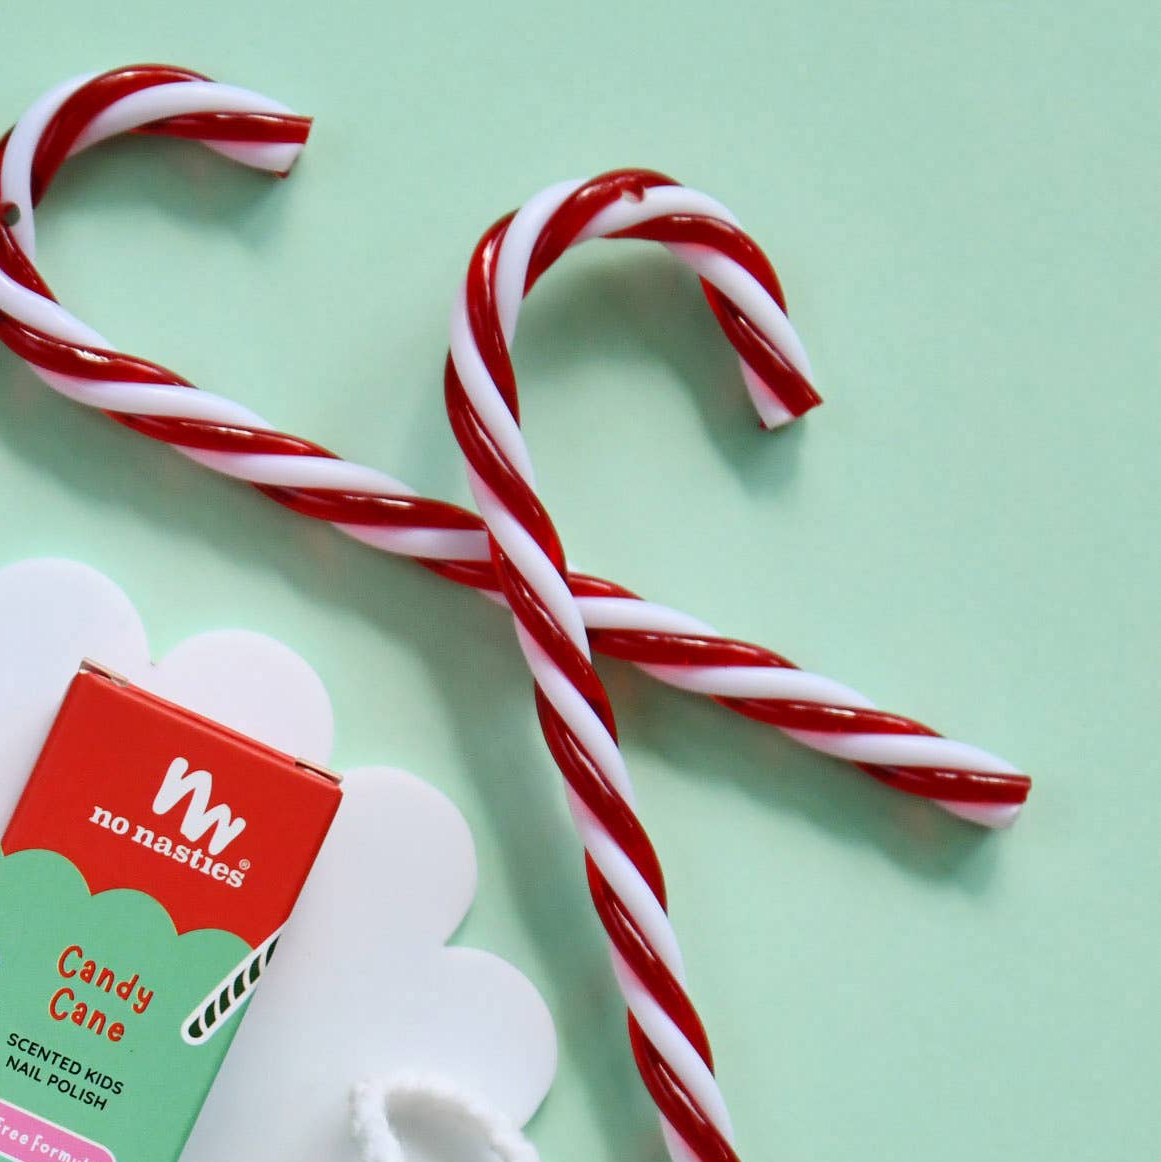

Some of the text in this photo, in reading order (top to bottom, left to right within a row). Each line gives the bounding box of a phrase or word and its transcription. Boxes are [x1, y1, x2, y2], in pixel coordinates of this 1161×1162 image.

[88, 805, 129, 835] no
[56, 945, 154, 1015] Candy
[48, 987, 125, 1042] Cane
[6, 1033, 124, 1095] SCENTED KIDS
[6, 1055, 107, 1111] NAIL POLISH
